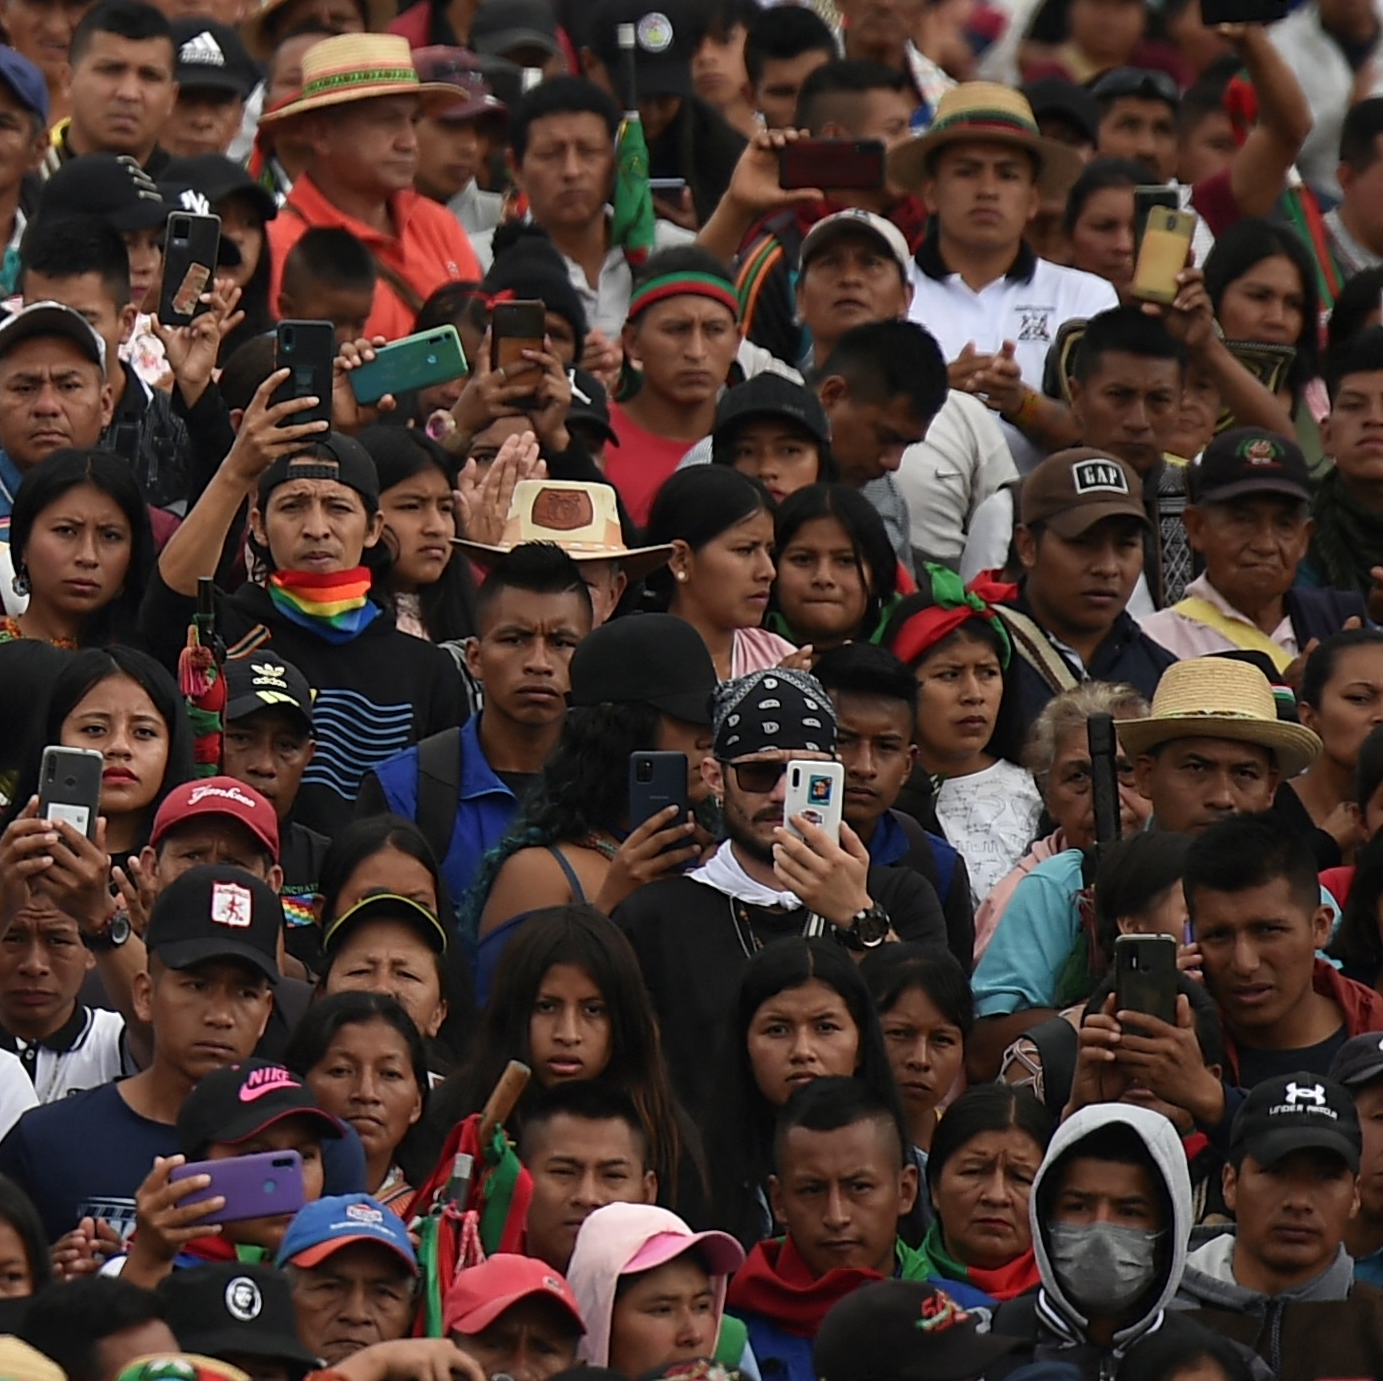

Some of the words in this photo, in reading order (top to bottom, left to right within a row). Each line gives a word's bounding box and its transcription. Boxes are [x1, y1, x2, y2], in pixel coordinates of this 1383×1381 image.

[1082, 465, 1118, 486] GAP
[252, 676, 287, 690] adidas
[187, 784, 256, 809] Yankees
[248, 1066, 293, 1087] NIKE
[1269, 1103, 1304, 1116] UNDER
